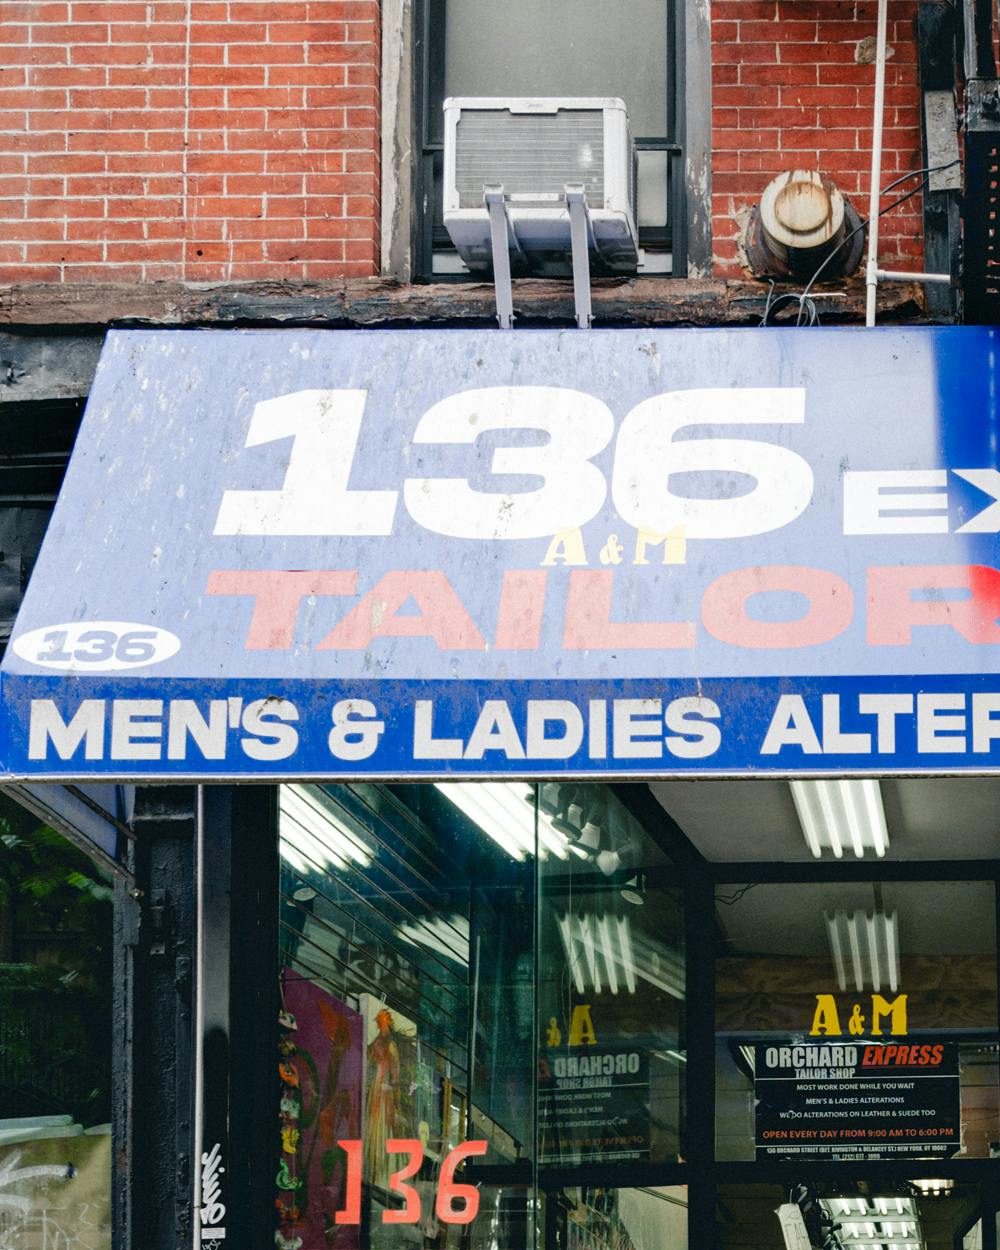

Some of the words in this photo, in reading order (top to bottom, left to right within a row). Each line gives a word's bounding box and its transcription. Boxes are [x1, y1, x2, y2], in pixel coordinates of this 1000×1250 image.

[213, 386, 815, 539] 136
[36, 630, 157, 662] 136
[28, 697, 298, 761] MEN'S
[328, 700, 384, 760] &
[413, 697, 721, 760] LADIES
[765, 1046, 858, 1069] ORCHARD
[861, 1044, 945, 1066] EXPRESS
[794, 1068, 828, 1079] TAILOR
[829, 1067, 856, 1079] SHOP
[817, 1083, 839, 1091] WORK
[839, 1083, 859, 1091] DONE
[860, 1082, 881, 1090] WHILE
[881, 1082, 898, 1090] YOU
[834, 1097, 859, 1105] LADIES
[859, 1096, 905, 1104] ALTERATIONS
[804, 1110, 848, 1119] ALTERATIONS
[849, 1110, 860, 1118] ON
[861, 1110, 891, 1118] LEATHER
[898, 1109, 920, 1117] SUEDE
[920, 1109, 936, 1117] TOO
[762, 1130, 788, 1139] OPEN
[789, 1129, 817, 1138] EVERY
[819, 1129, 838, 1139] DAY
[839, 1129, 866, 1138] FROM
[867, 1128, 887, 1138] 9:00
[888, 1128, 903, 1137] AM
[904, 1128, 917, 1137] TO
[918, 1127, 938, 1137] 6:00
[939, 1126, 954, 1136] PM
[335, 1139, 488, 1225] 136
